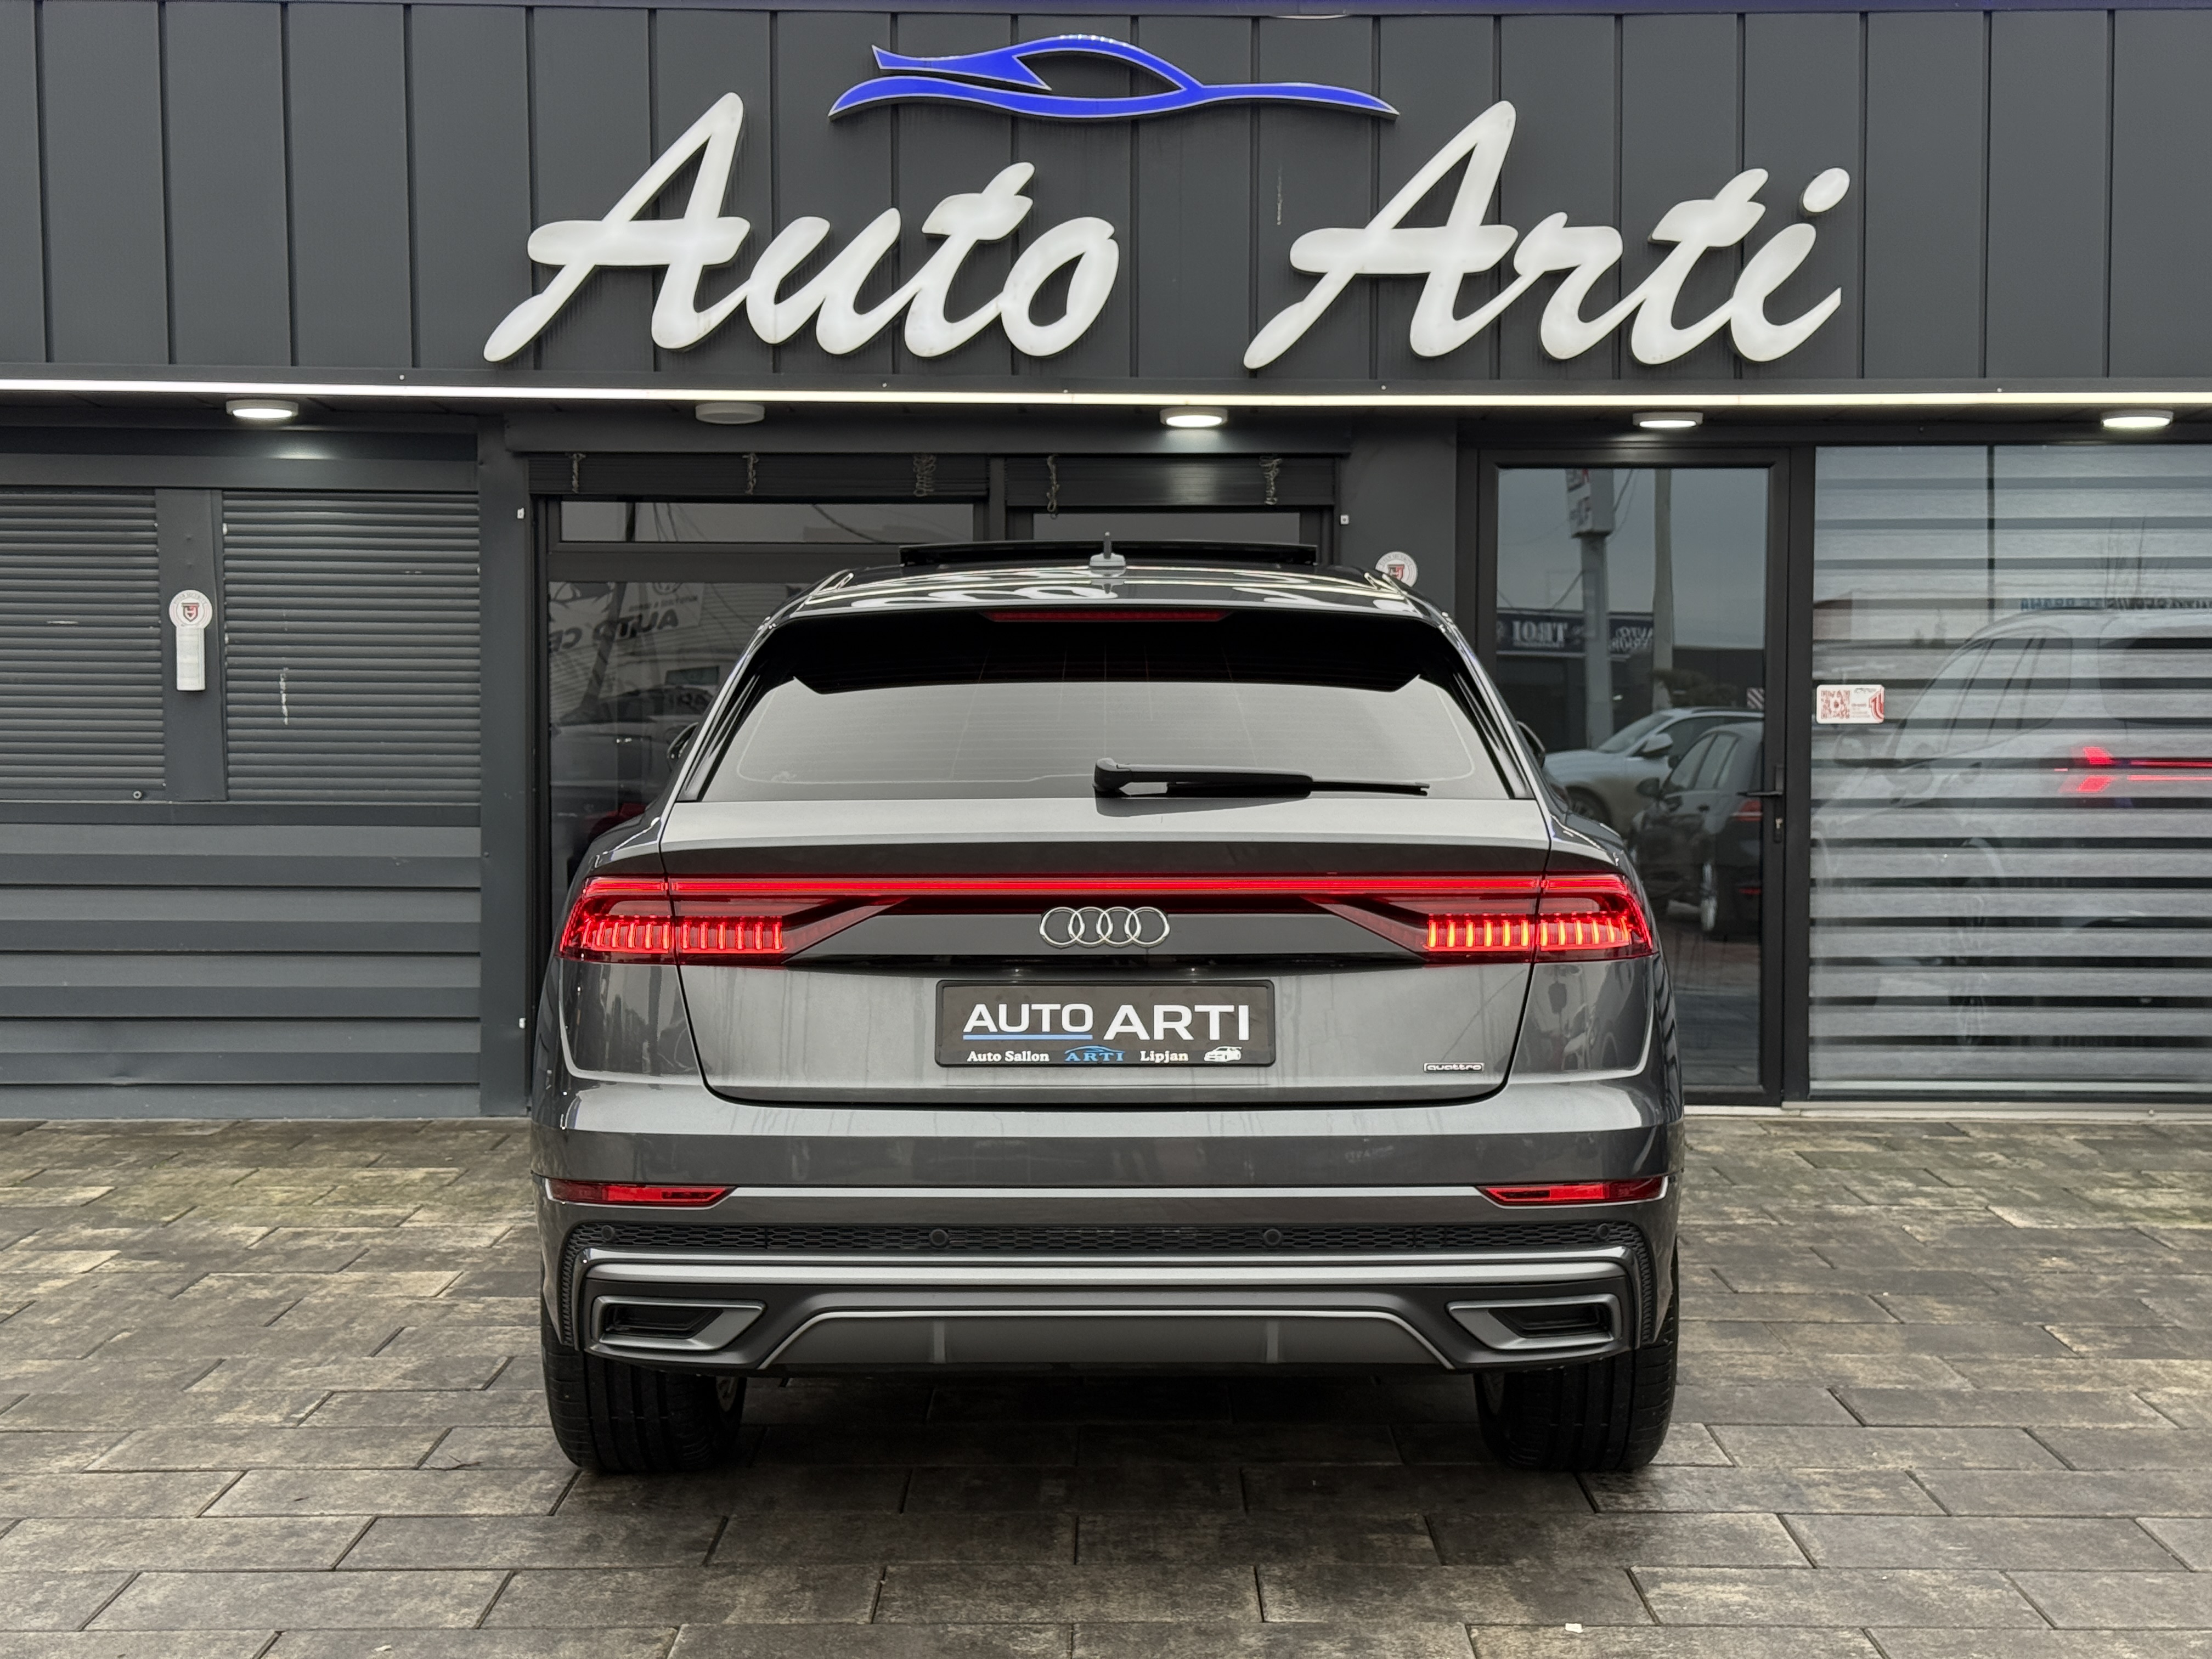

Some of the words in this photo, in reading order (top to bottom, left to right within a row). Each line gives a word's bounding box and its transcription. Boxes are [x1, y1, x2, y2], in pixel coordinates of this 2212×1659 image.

[484, 92, 1119, 362] Auto
[1243, 100, 1850, 369] Arti
[963, 1004, 1093, 1032] AUTO
[1103, 1005, 1250, 1040] ARTI
[967, 1051, 1002, 1062] Auto
[1005, 1051, 1050, 1062] Sallon
[1065, 1052, 1124, 1062] ARTI
[1140, 1051, 1189, 1063] Lipjan
